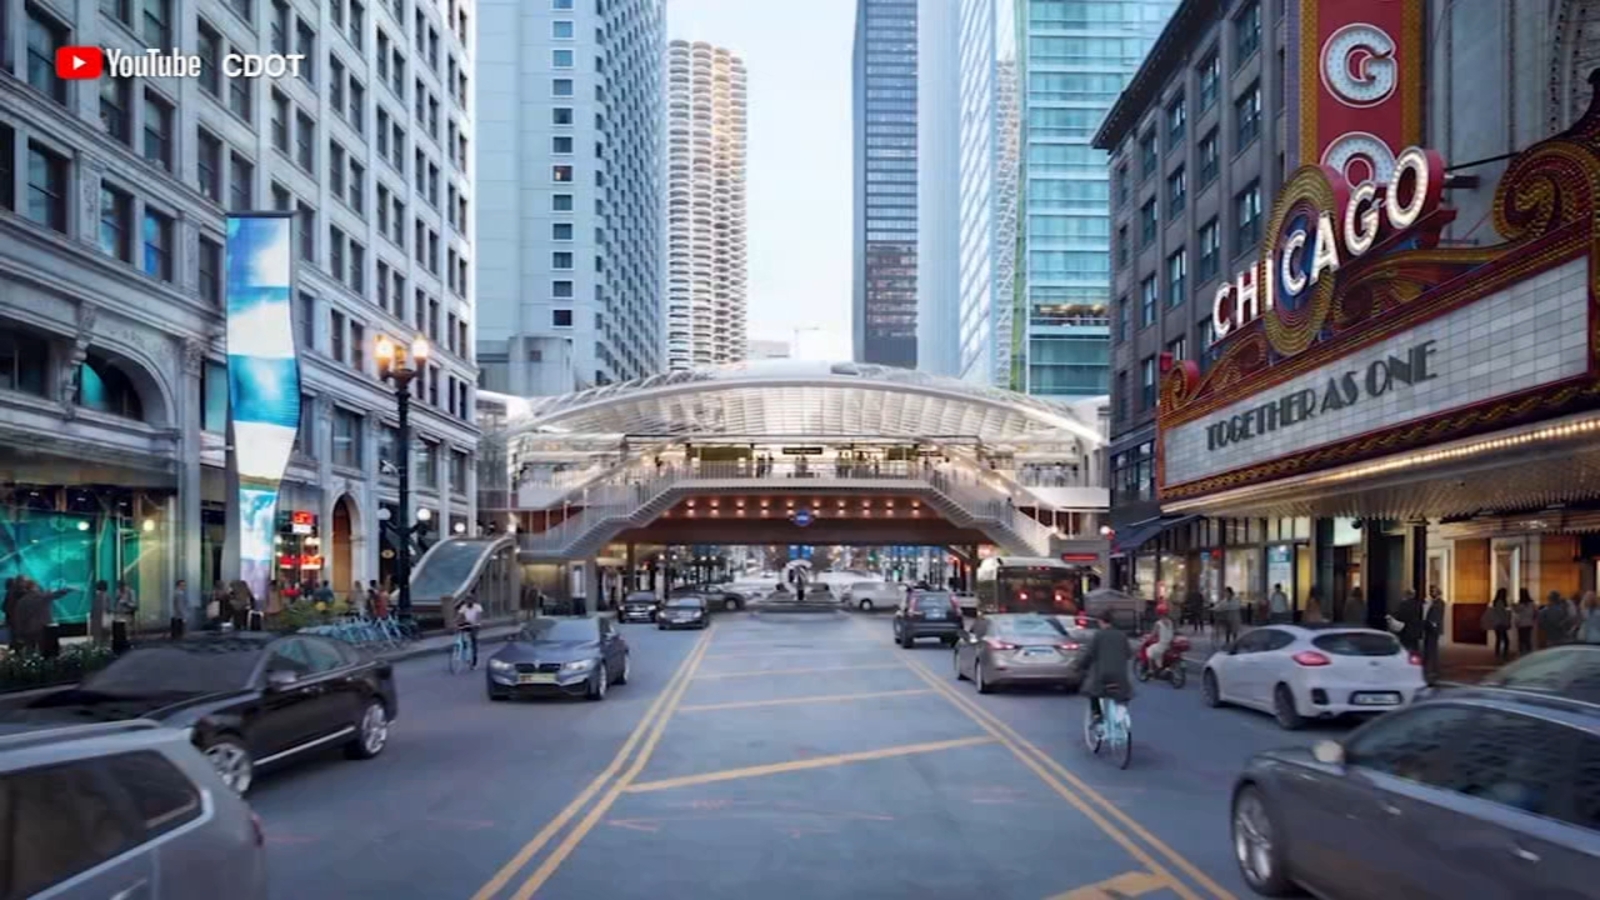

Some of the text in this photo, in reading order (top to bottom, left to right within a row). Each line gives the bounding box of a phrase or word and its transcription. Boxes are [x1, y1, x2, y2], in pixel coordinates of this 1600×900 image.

[1212, 146, 1430, 338] CHICAGO
[1204, 339, 1438, 451] TOGETHER AS ONE
